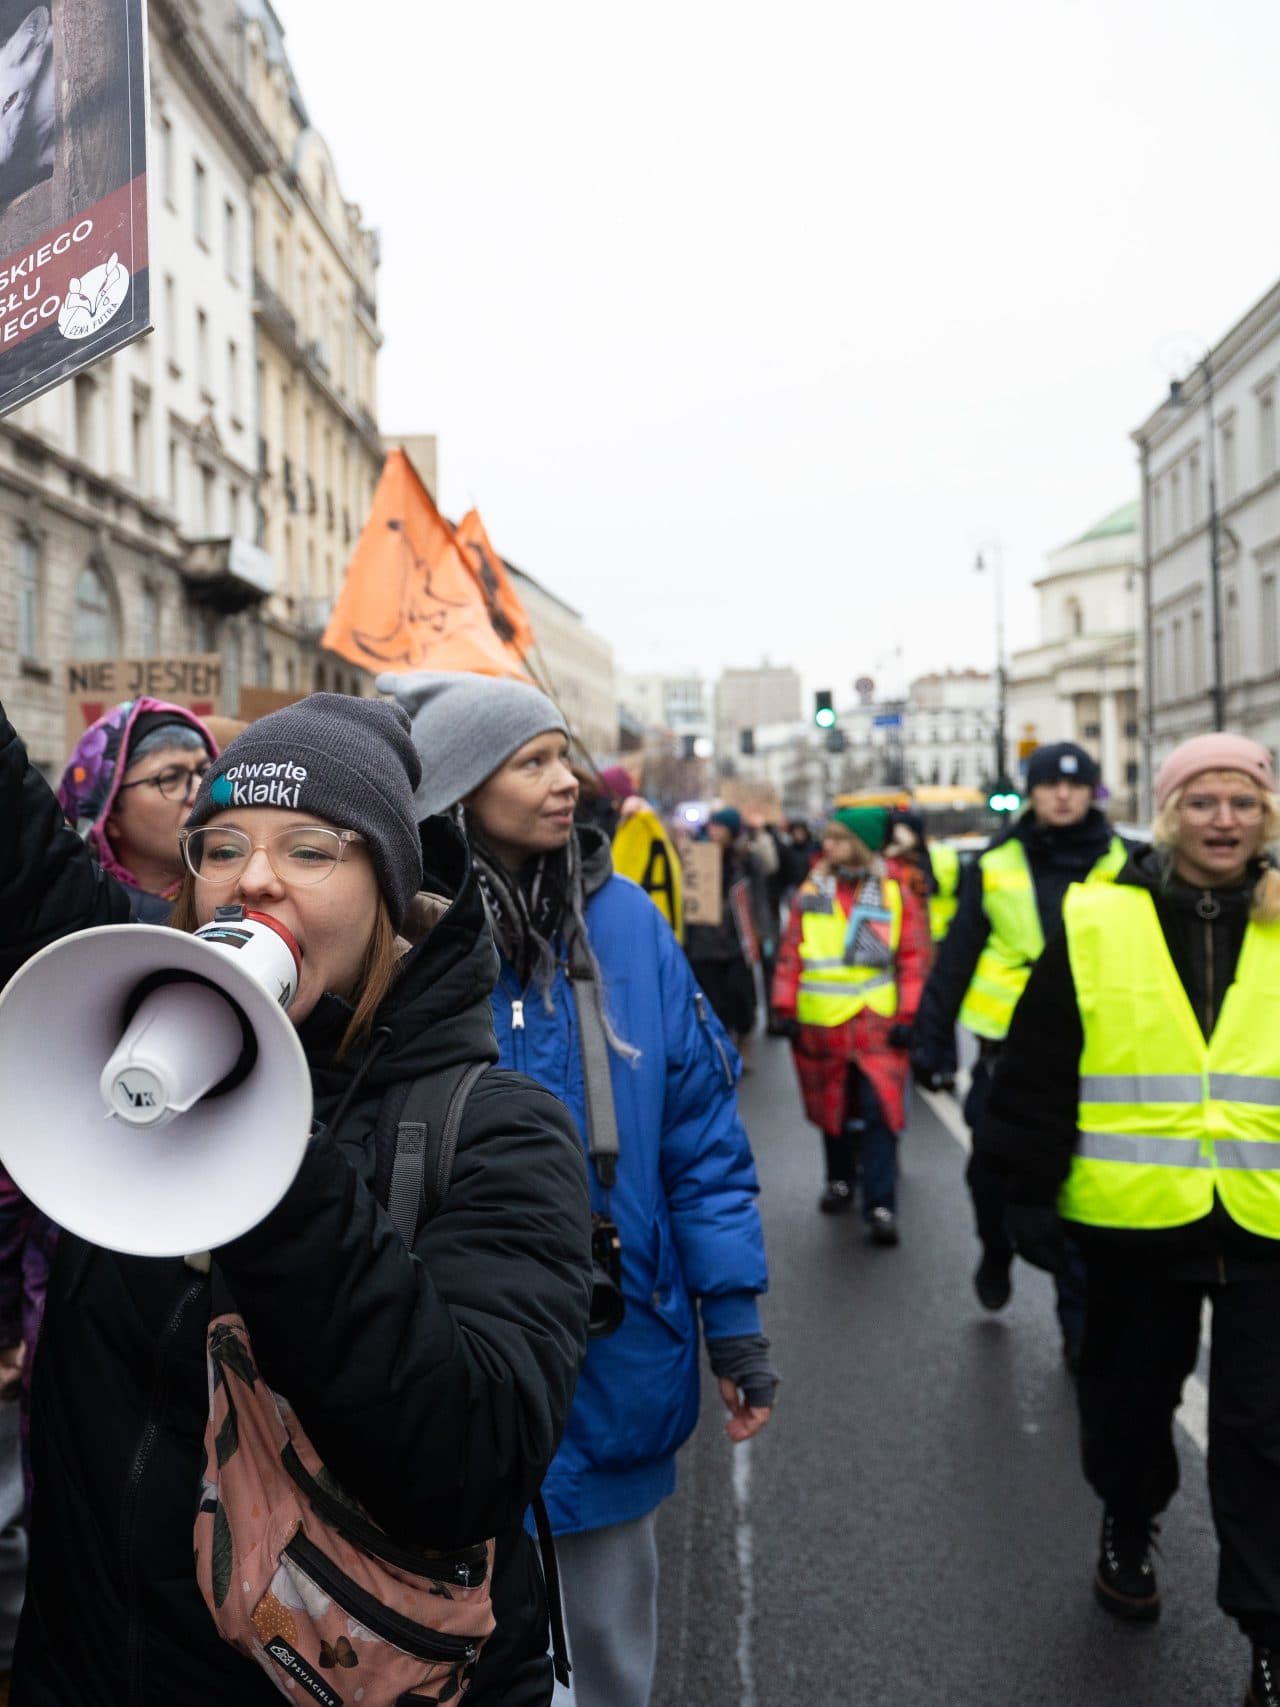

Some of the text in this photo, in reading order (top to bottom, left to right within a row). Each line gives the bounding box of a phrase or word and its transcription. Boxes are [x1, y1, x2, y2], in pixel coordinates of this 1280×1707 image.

[68, 660, 222, 697] NIE JESTEM
[226, 761, 308, 781] otwarte
[232, 779, 302, 809] klatki
